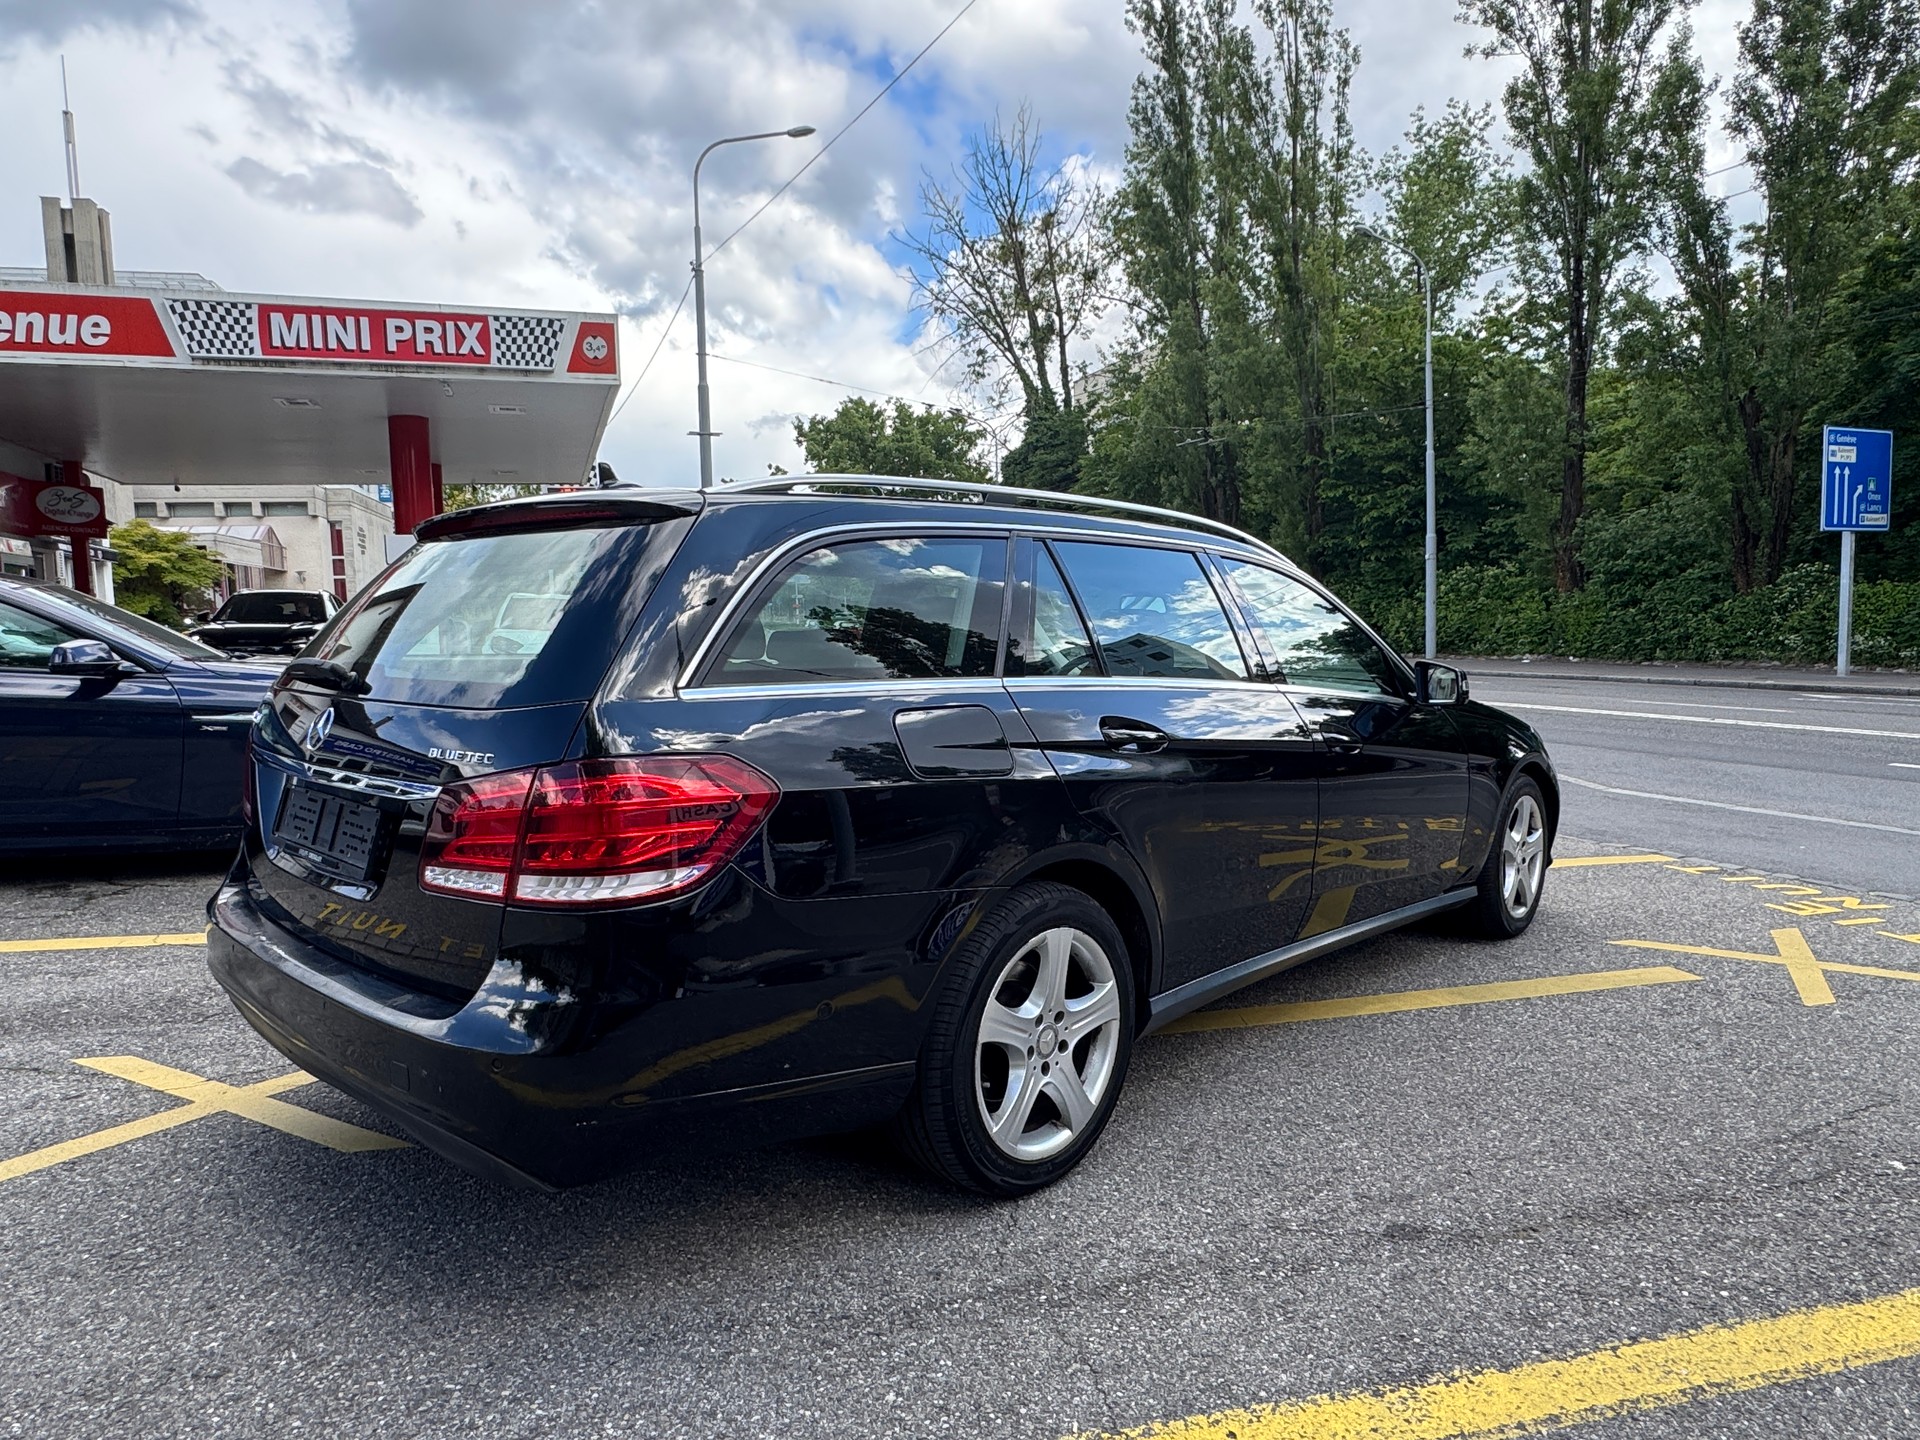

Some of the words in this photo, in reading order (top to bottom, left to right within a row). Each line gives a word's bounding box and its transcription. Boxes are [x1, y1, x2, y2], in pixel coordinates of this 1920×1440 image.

[268, 312, 372, 351] MINI
[384, 318, 486, 356] PRIX
[428, 747, 495, 765] BLUETEC
